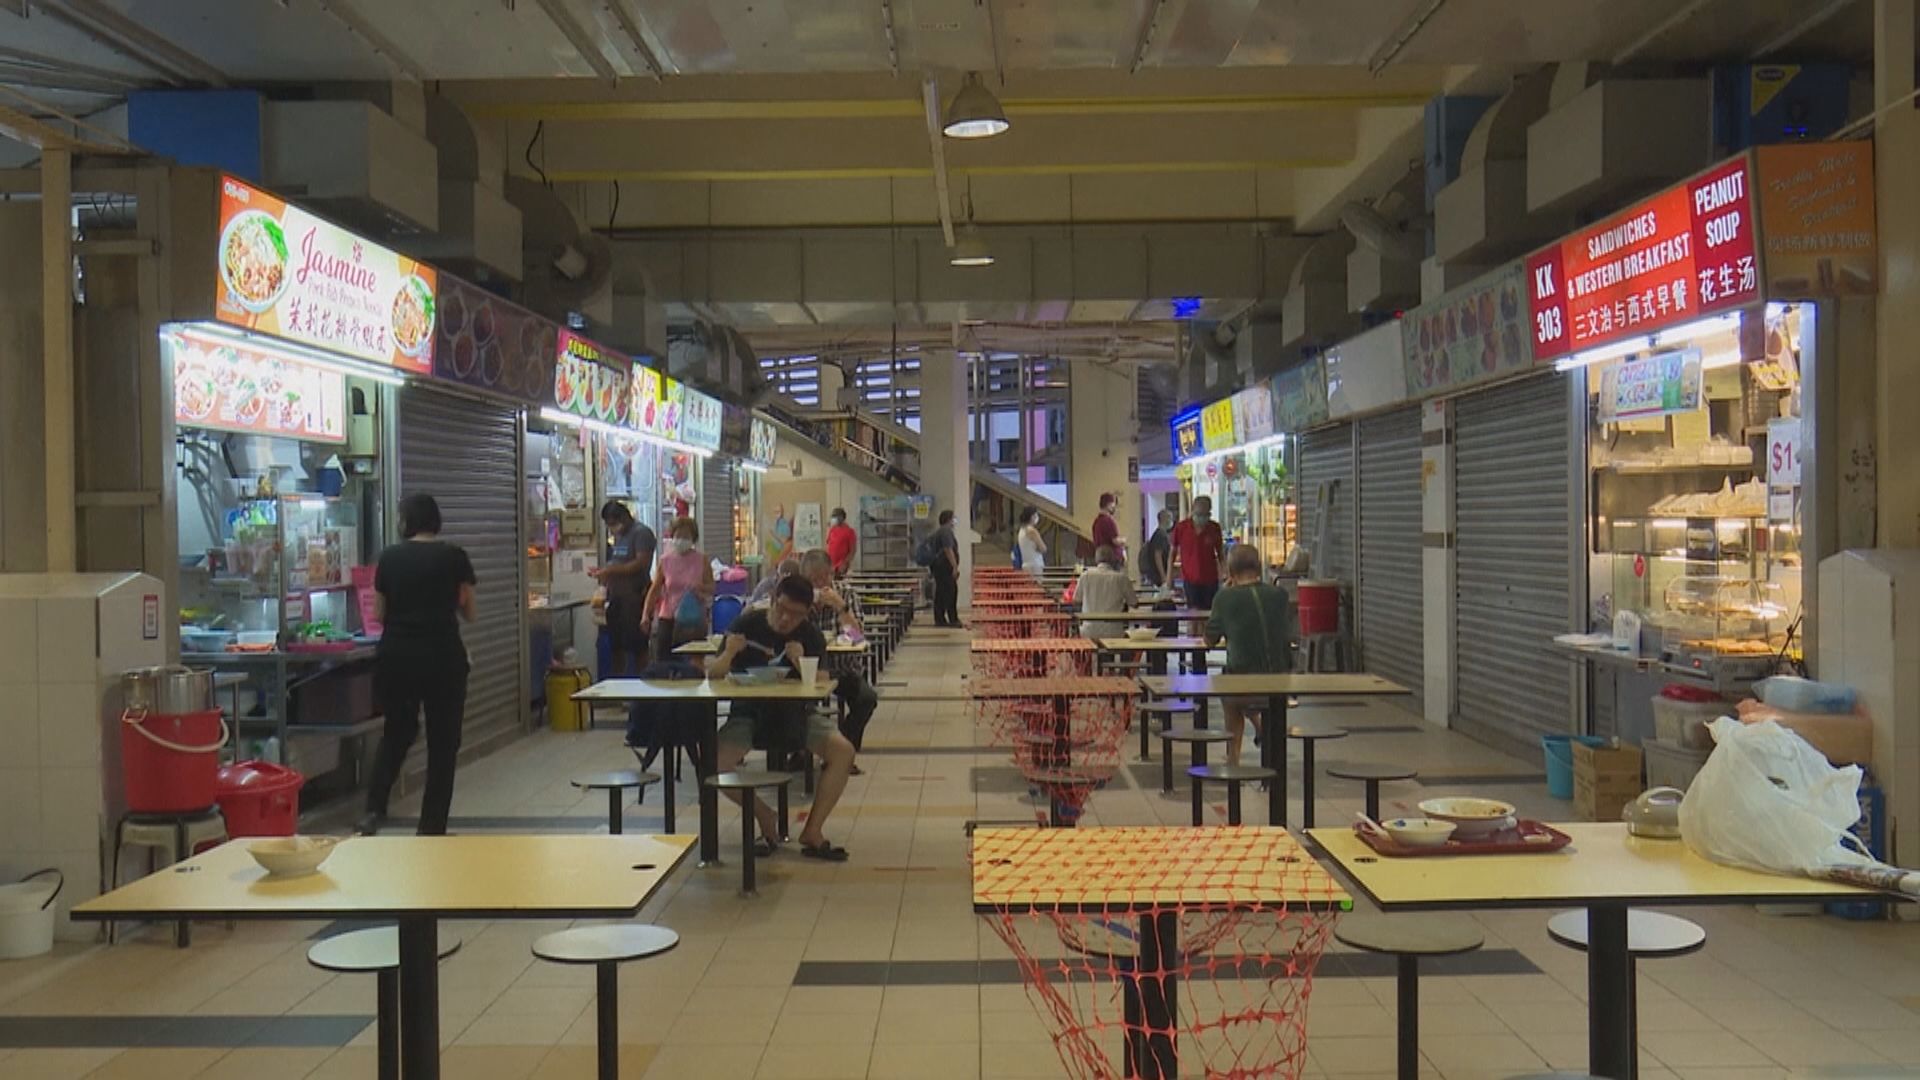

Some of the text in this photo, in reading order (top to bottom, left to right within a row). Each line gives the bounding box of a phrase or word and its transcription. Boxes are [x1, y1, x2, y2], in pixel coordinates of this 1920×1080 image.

[1695, 170, 1743, 216] PEANUT
[1588, 210, 1656, 261] SANDWICHES
[1706, 211, 1740, 248] SOUP
[296, 226, 376, 293] Jasmine
[1535, 262, 1556, 300] KK
[1567, 232, 1690, 300] & WESTERN BREAKFAST
[1699, 256, 1755, 304] 花生汤
[1536, 306, 1562, 344] 303
[1575, 278, 1687, 340] 三文治与西式早餐
